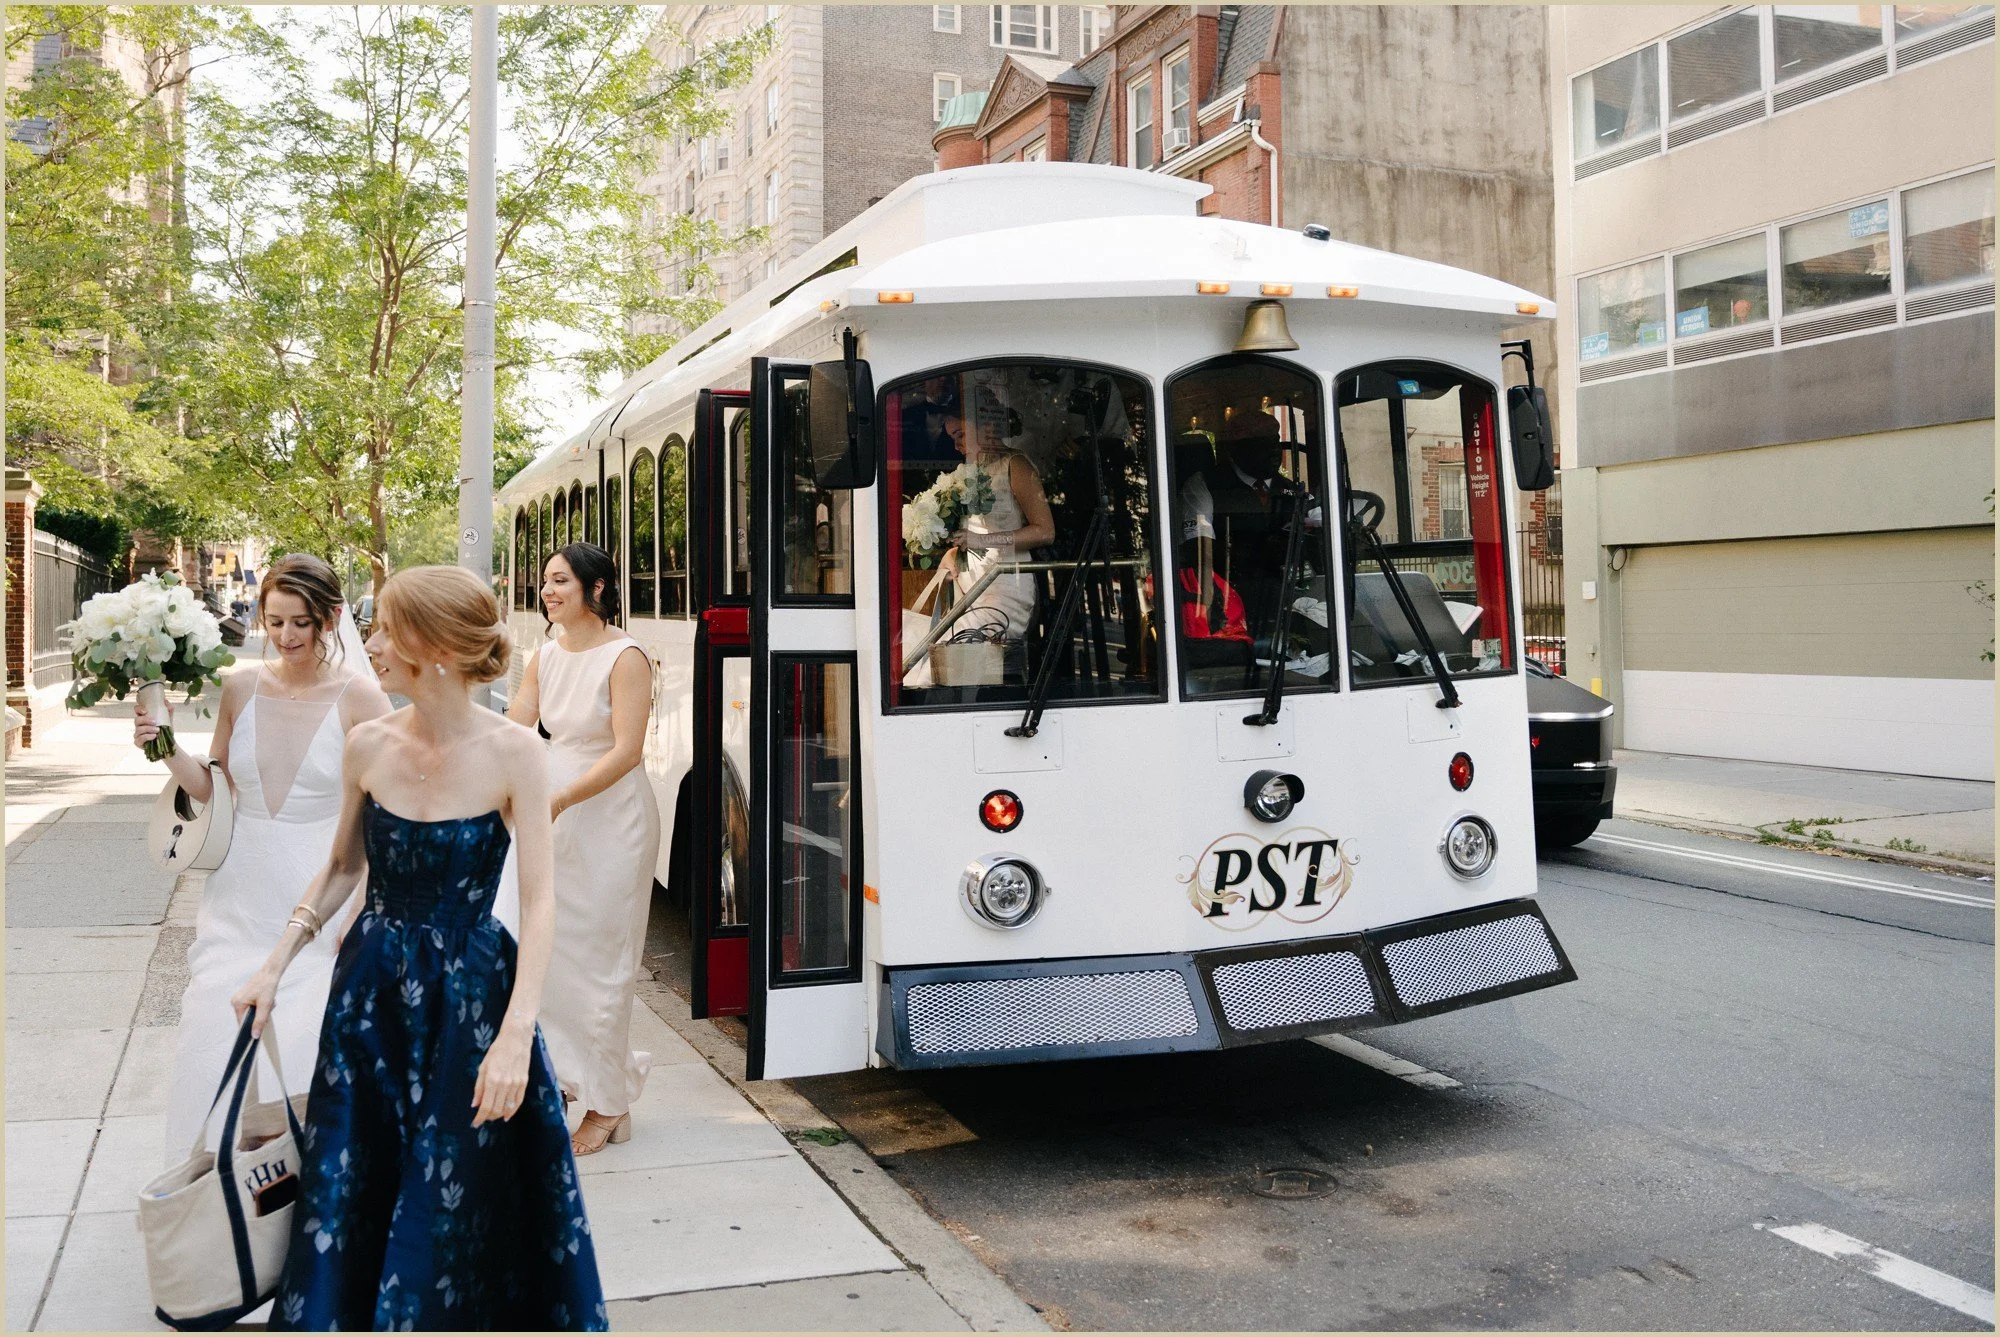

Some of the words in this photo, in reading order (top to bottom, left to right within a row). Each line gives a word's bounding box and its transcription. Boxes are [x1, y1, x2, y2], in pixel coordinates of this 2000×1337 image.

[1683, 314, 1702, 324] UNION
[1680, 321, 1705, 332] STRONG
[1473, 413, 1482, 471] CAUTION
[1470, 473, 1489, 481] Vehicle
[1471, 481, 1489, 490] Height
[1203, 839, 1339, 918] PST
